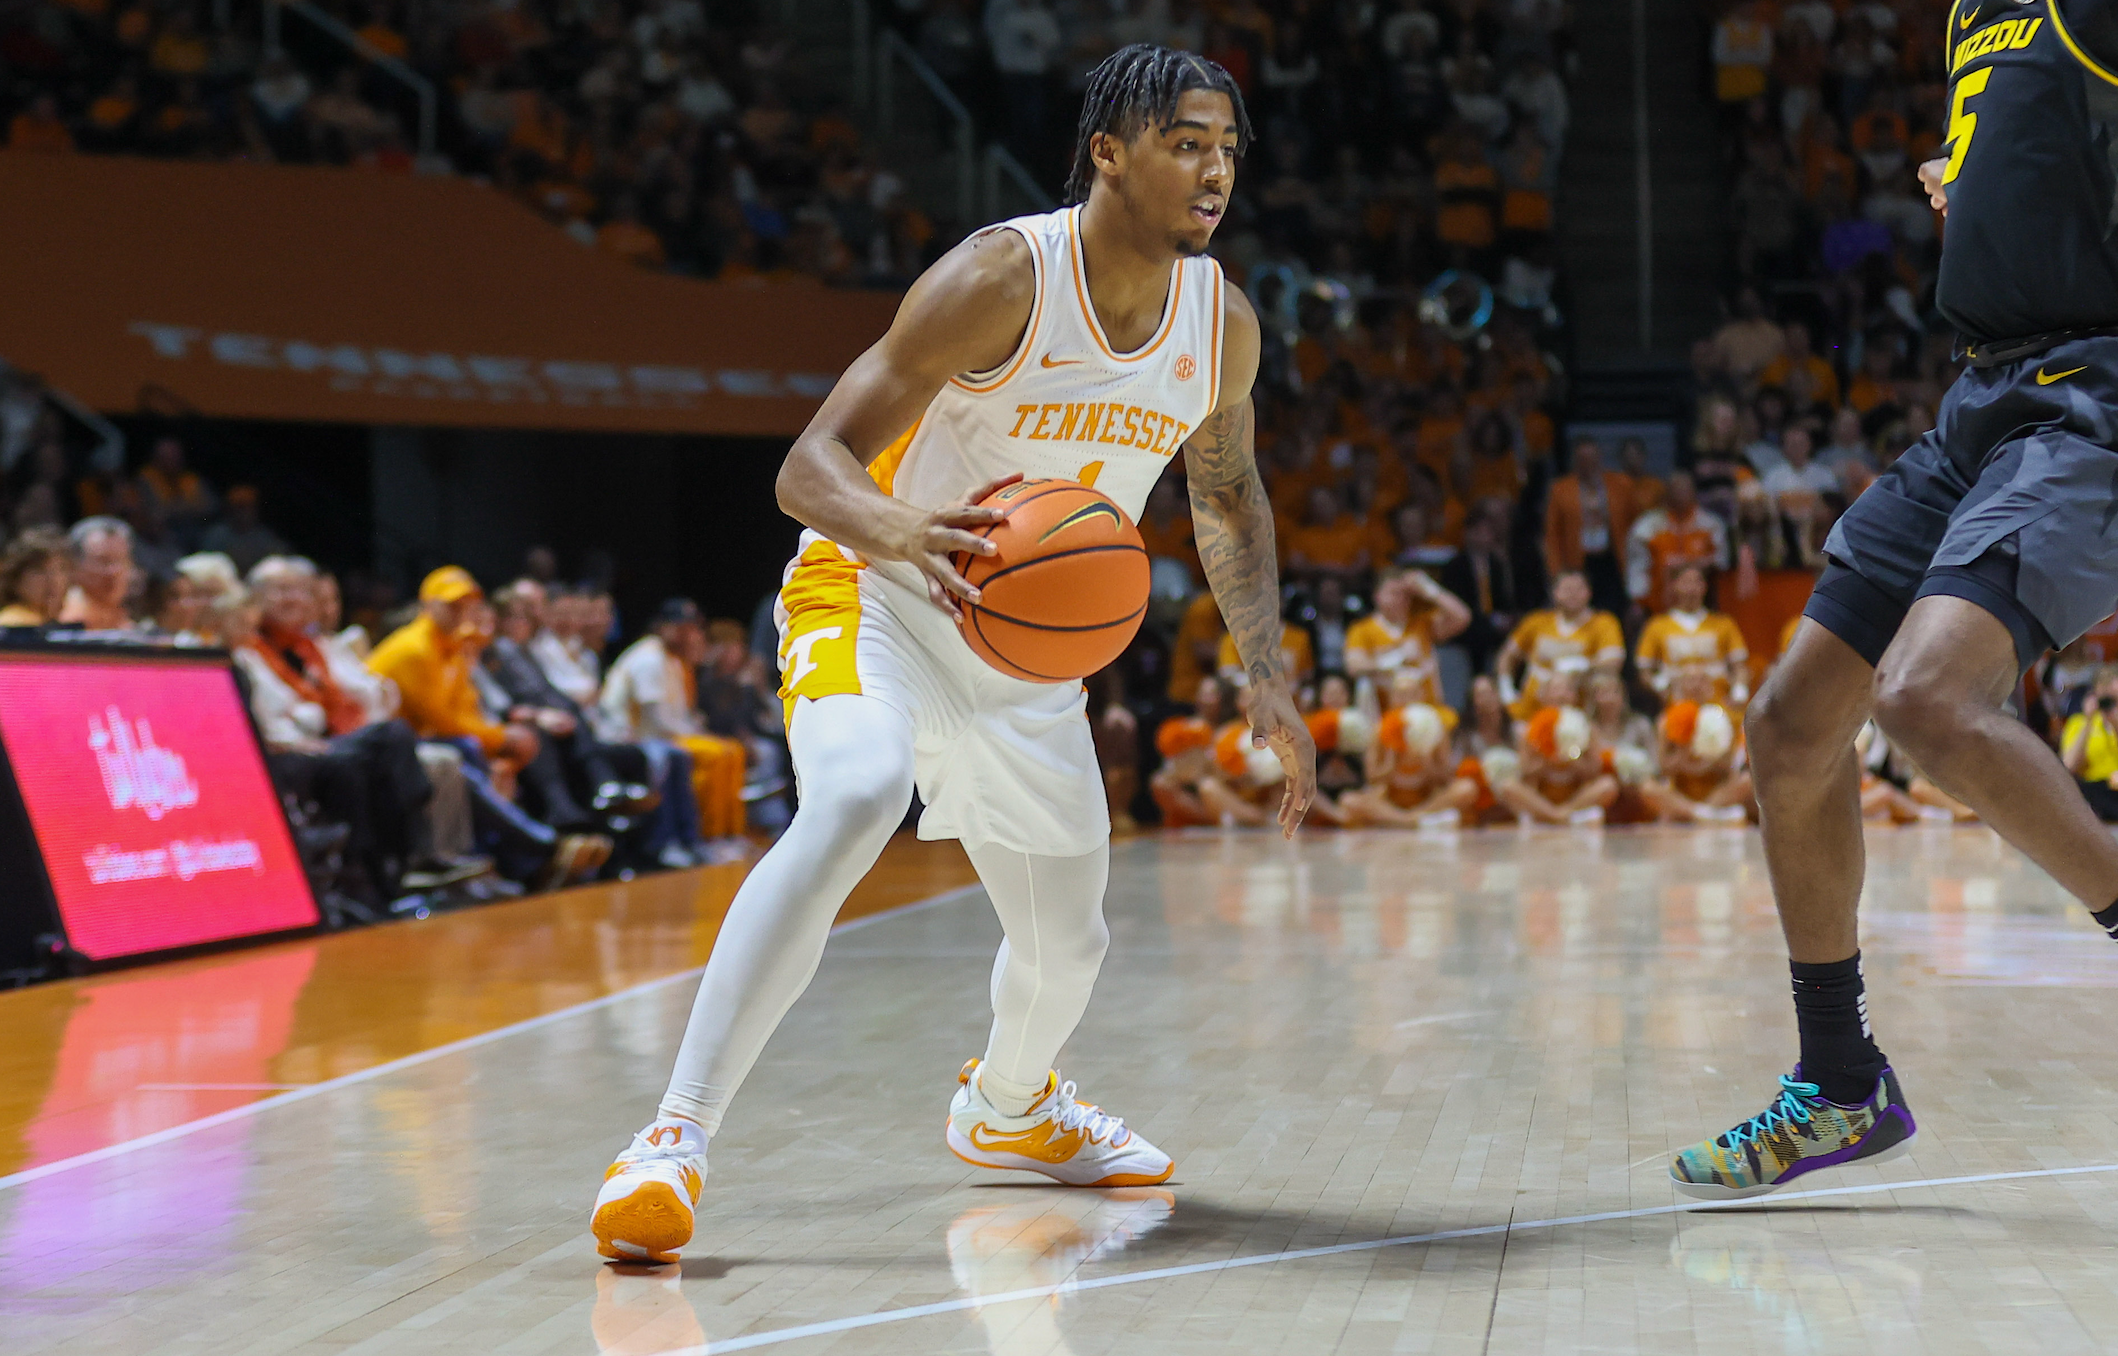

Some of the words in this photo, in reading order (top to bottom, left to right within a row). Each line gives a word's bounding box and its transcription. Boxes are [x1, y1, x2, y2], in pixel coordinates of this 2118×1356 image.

[1942, 66, 1994, 186] 5
[1175, 356, 1195, 380] SEC
[1008, 402, 1190, 457] TENNESSEE
[784, 626, 843, 691] T
